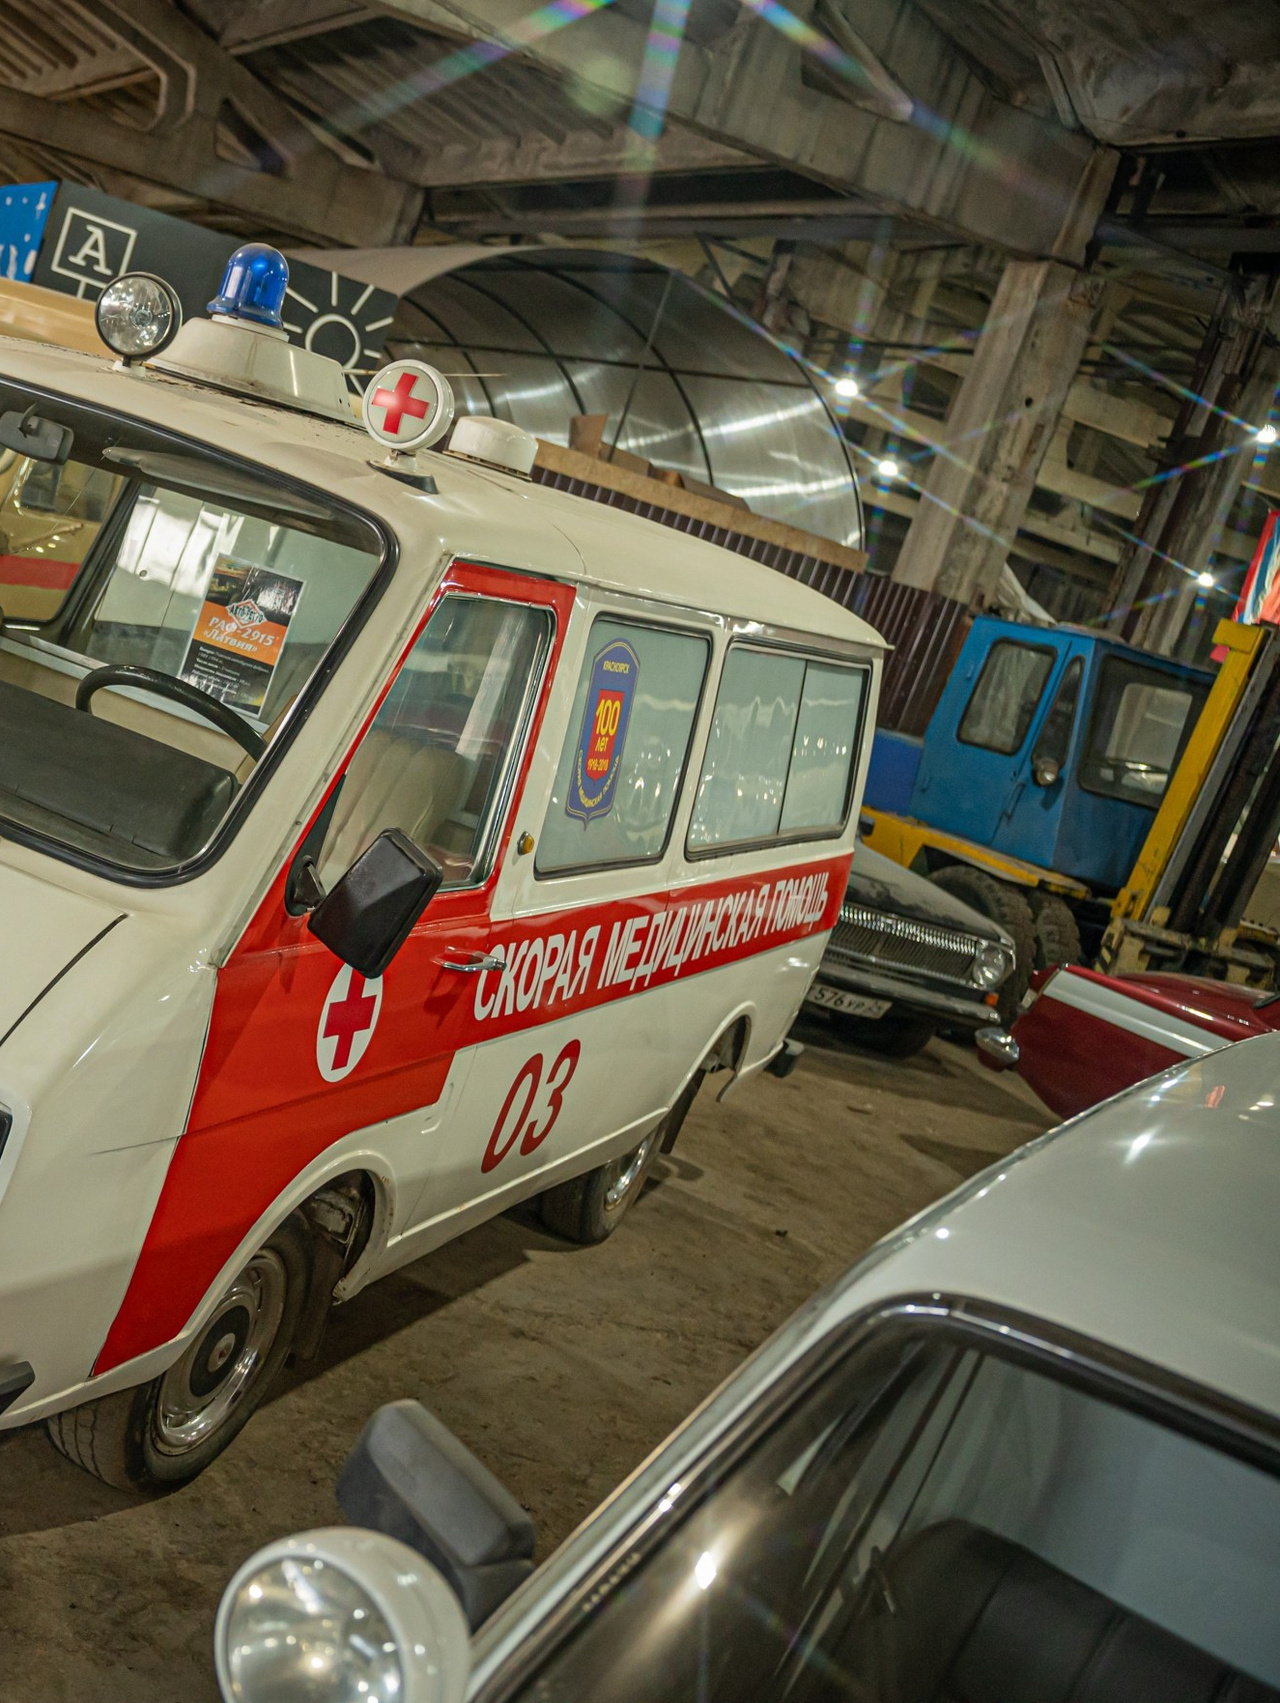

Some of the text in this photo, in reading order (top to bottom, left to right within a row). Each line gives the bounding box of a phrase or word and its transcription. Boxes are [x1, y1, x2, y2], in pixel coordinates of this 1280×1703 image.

[208, 616, 275, 647] РАФ-2915
[595, 699, 621, 736] 100
[474, 871, 830, 1021] СКОРАЯ МЕДИЦИНСКАЯ ПОМОЩЬ
[481, 1039, 581, 1174] 03
